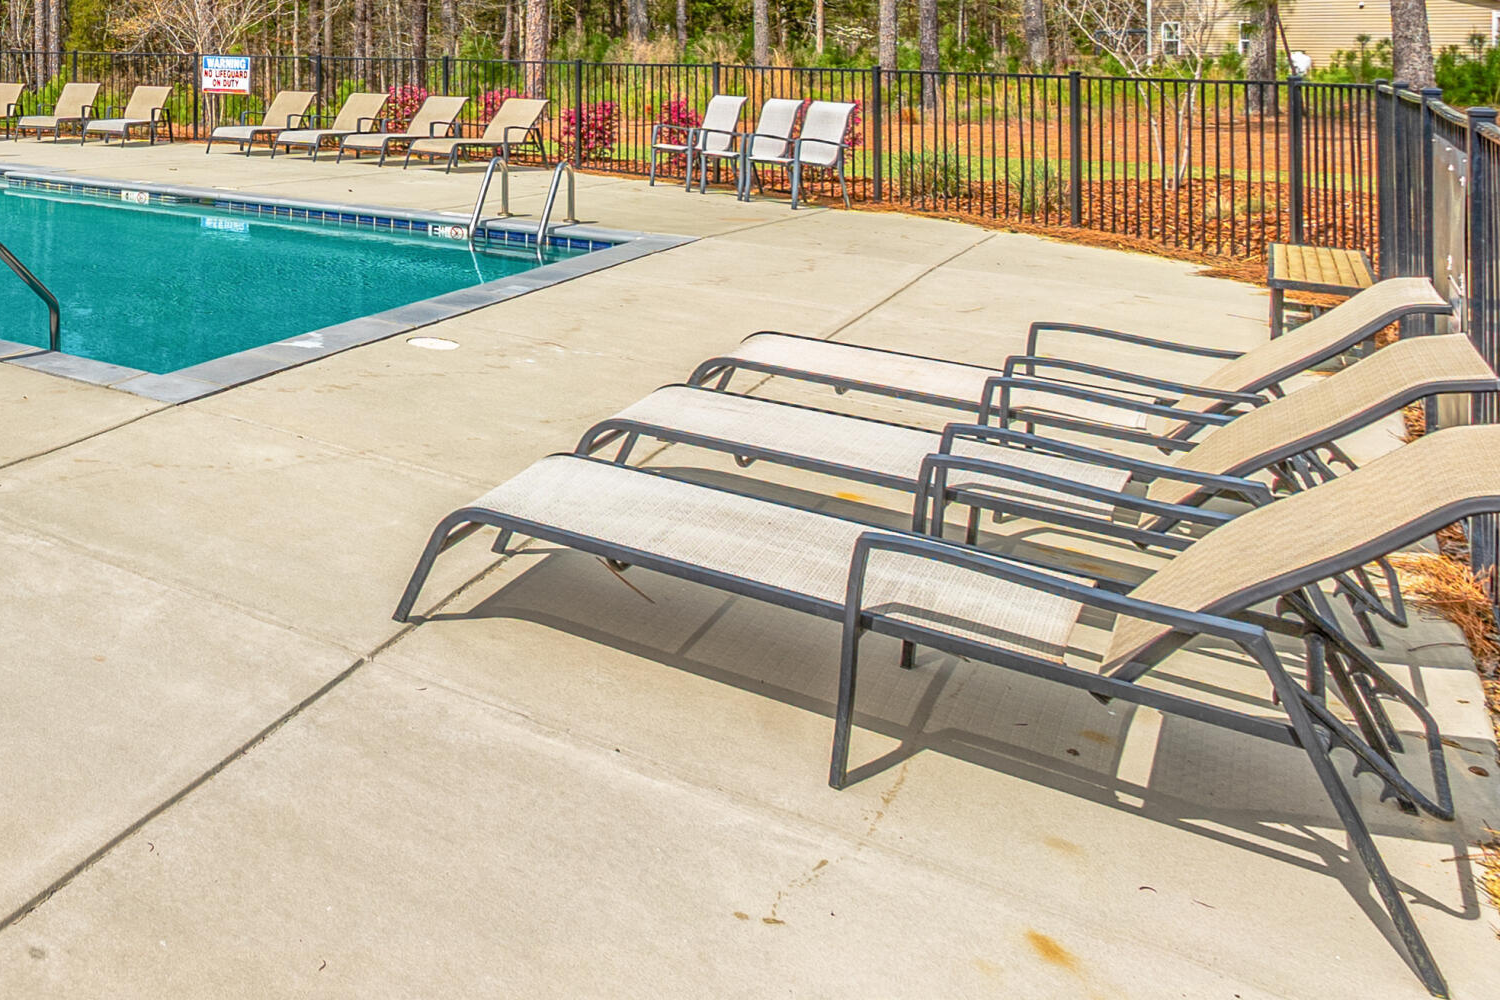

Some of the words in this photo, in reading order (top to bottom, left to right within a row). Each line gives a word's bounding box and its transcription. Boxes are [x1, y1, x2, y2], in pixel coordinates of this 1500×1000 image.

[206, 58, 246, 69] WARNING
[215, 70, 247, 78] LIFEGUARD
[212, 79, 221, 87] ON
[223, 79, 239, 87] DUTY
